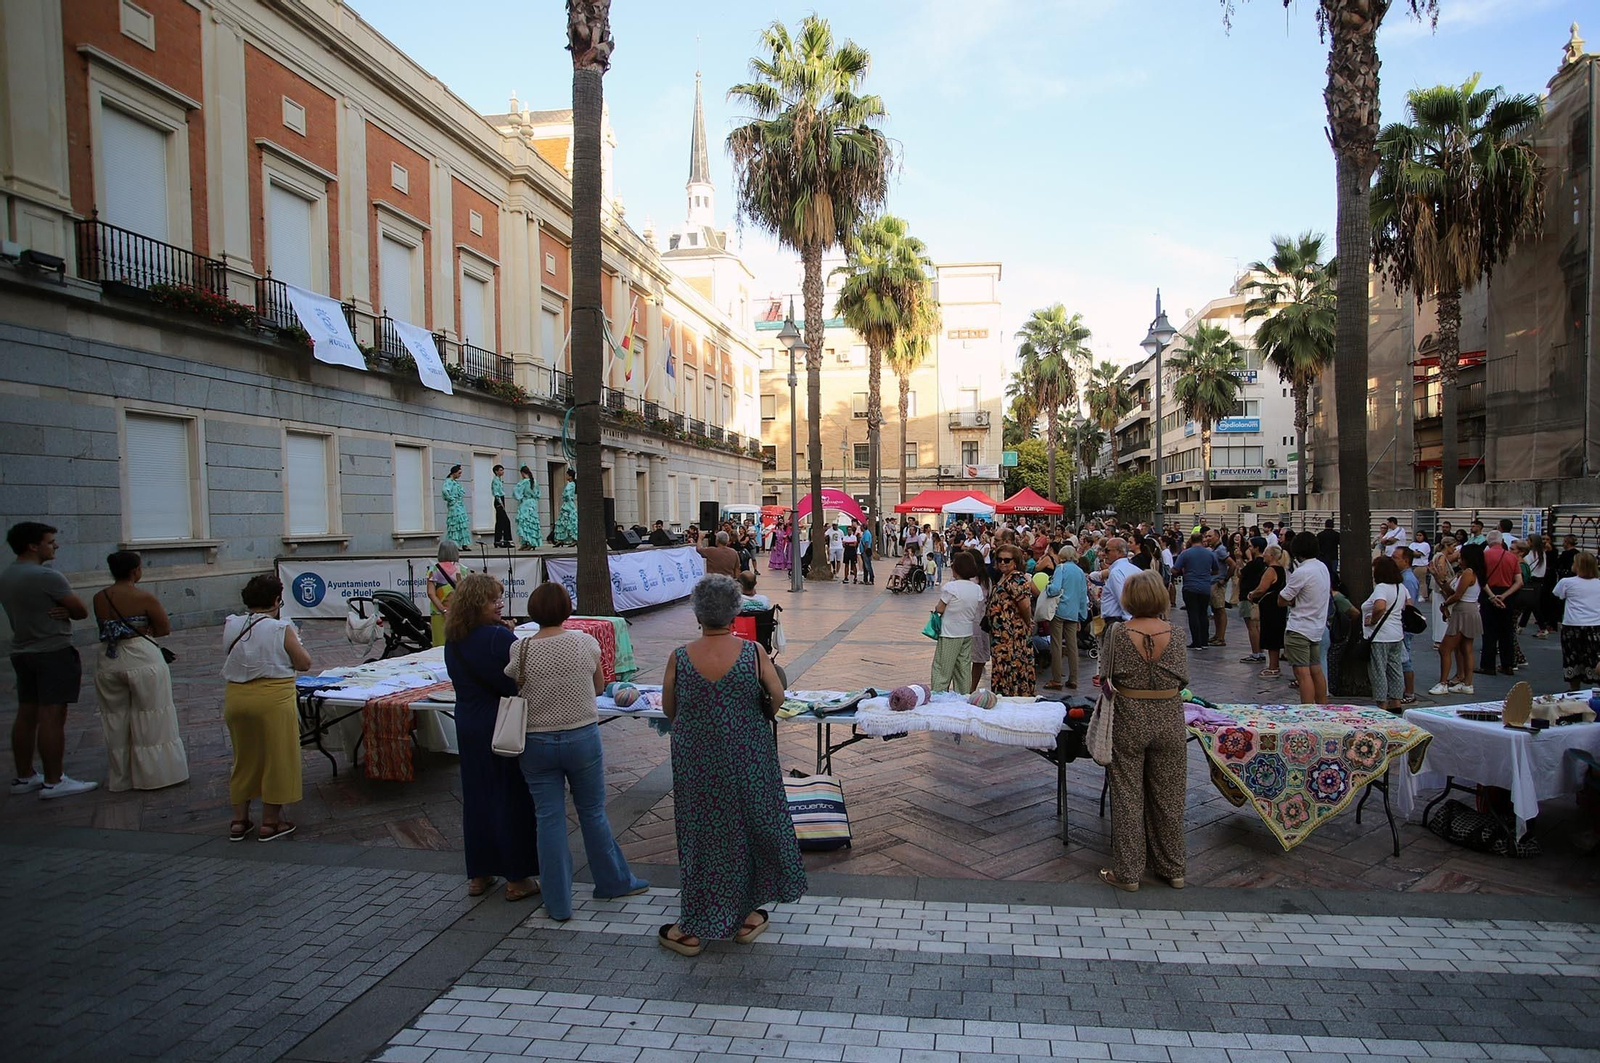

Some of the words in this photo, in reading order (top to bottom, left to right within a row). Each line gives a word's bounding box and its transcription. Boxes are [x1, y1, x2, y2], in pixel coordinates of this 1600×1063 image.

[327, 580, 381, 589] Ayuntamiento
[341, 589, 352, 597] de
[789, 803, 834, 811] encuentro
